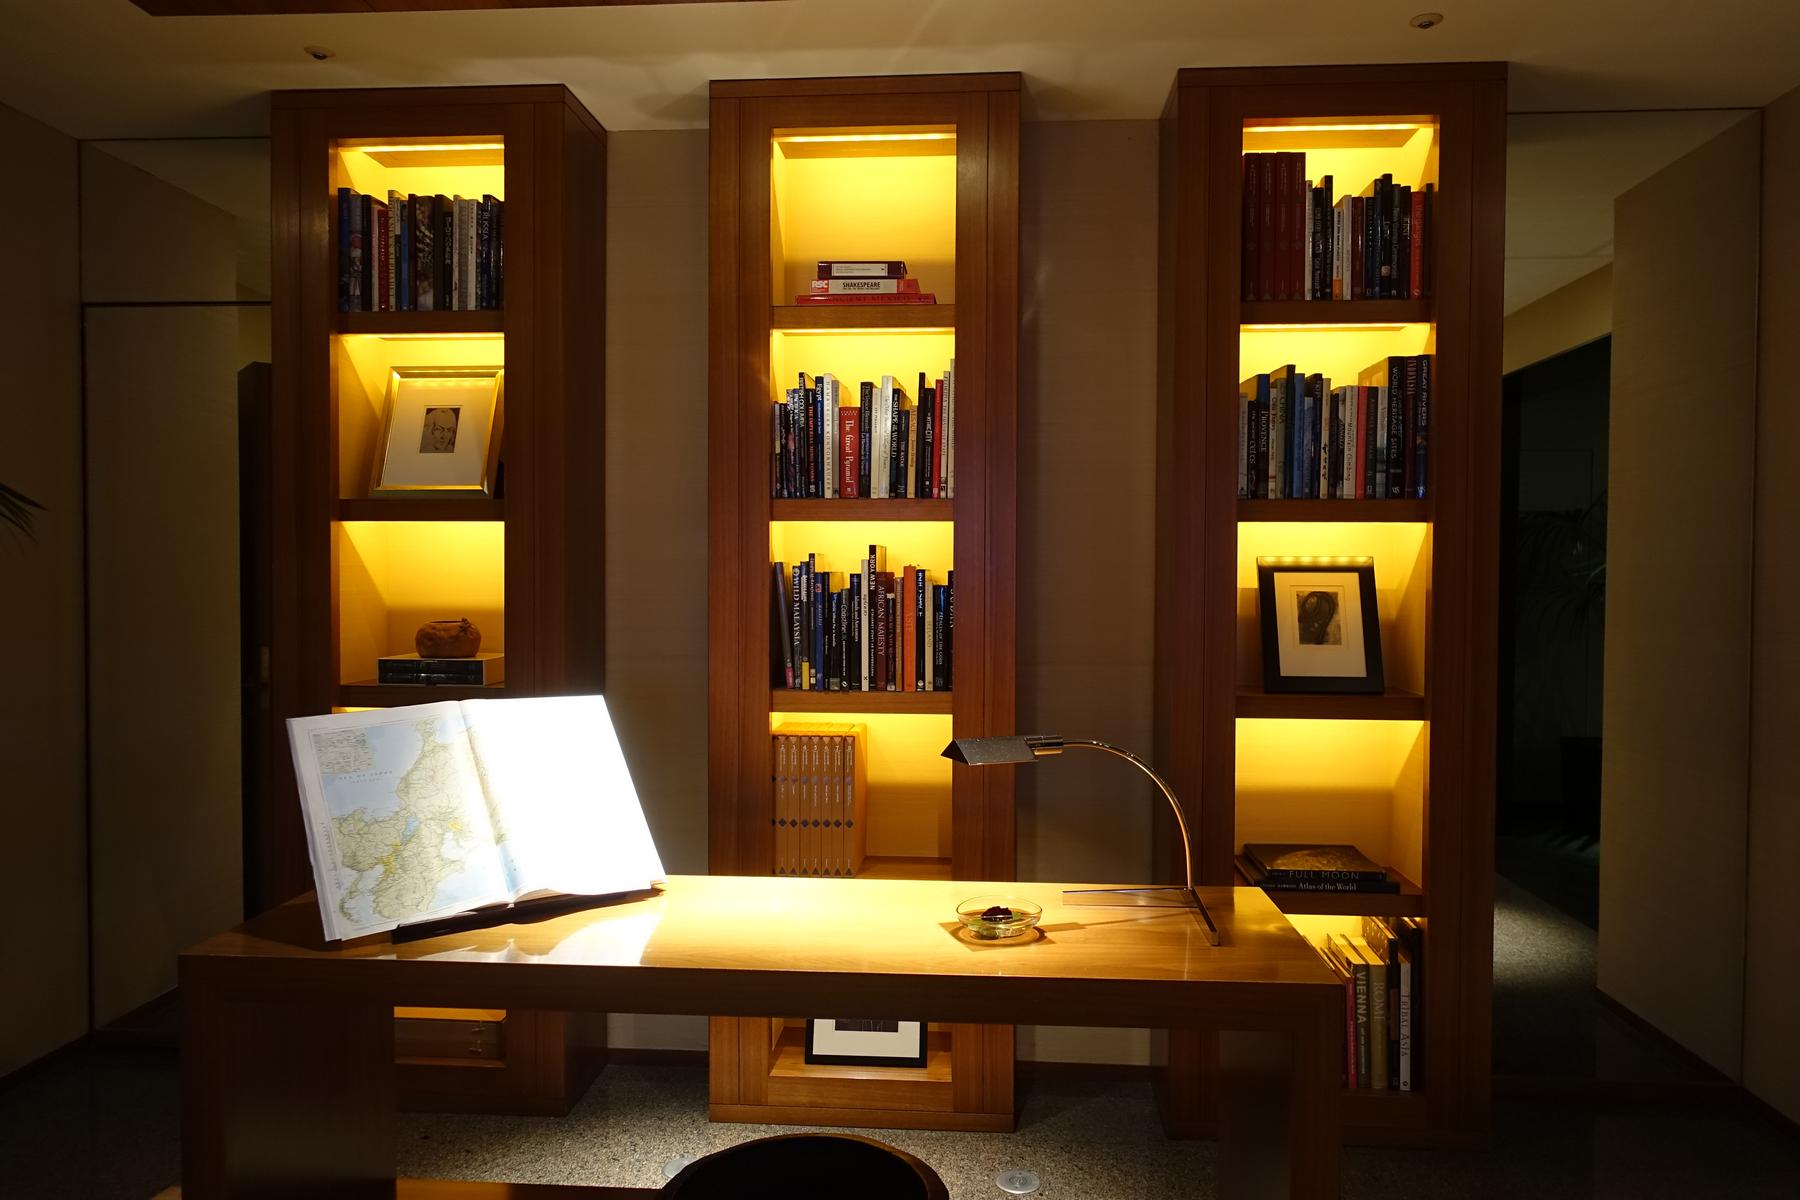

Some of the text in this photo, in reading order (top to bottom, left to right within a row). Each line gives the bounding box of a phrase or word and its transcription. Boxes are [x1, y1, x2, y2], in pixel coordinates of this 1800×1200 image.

[1390, 366, 1399, 459] WORLD HERITAGE SITES
[844, 419, 856, 483] The Great Pyramid
[890, 432, 898, 458] WORLD
[924, 430, 933, 443] CITY
[877, 584, 885, 656] AFRICAN MAJESTY
[1321, 871, 1360, 879] MOON
[1356, 971, 1367, 1024] VIENNA
[1373, 981, 1385, 1023] ROME
